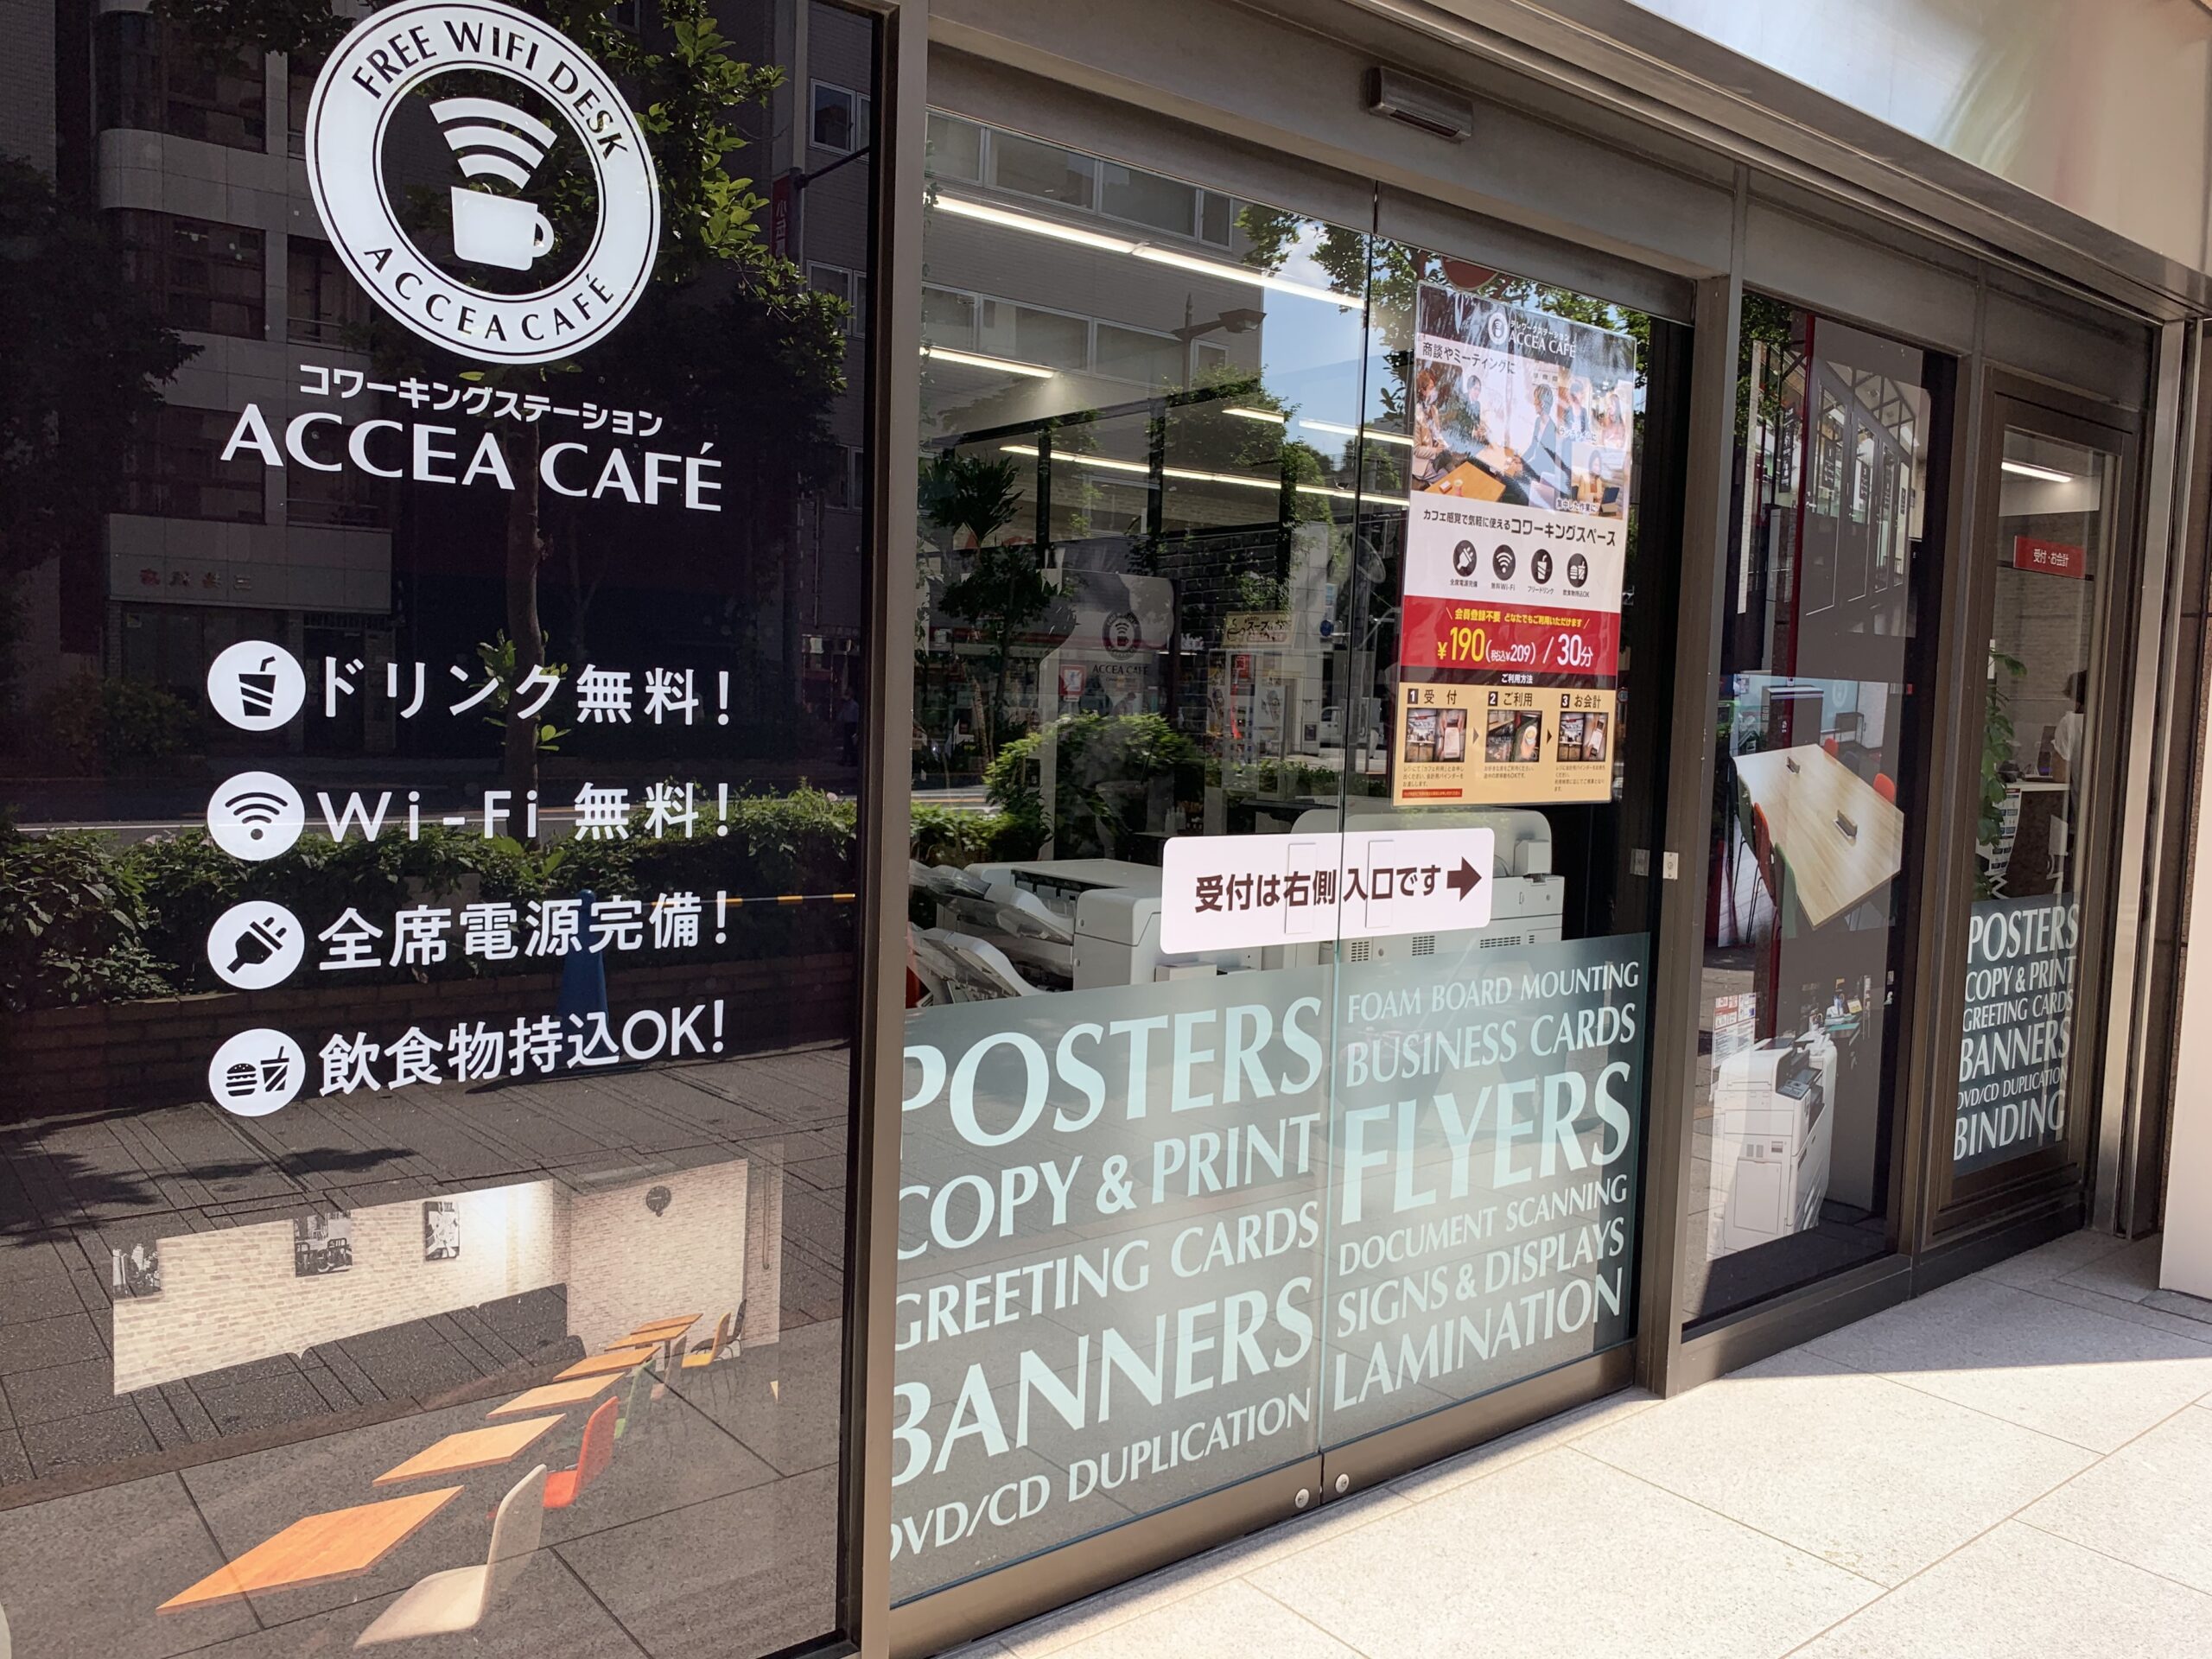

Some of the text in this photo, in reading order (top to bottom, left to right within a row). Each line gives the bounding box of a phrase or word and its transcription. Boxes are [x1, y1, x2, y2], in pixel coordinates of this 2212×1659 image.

[352, 20, 628, 162] FREE WIFI DESK
[364, 246, 614, 343] ACCEA CAFÉ
[1422, 342, 1516, 374] 商談やミーティングに
[1508, 330, 1546, 351] ACCEA
[1510, 320, 1570, 342] テレワークステーション
[299, 364, 663, 437] コワーキングステーション
[220, 403, 722, 512] ACCEA CAFÉ
[1423, 509, 1616, 547] カフェ感覚で気軽に使えるコワーキングスペース
[1556, 499, 1597, 512] 集中した作業に
[1454, 608, 1583, 627] 会員登録不要 どなたでもご利用いただけます
[1528, 586, 1554, 595] フリードリンク
[1092, 664, 1124, 675] ACCEA
[1501, 673, 1533, 685] ご利用方法
[1557, 633, 1593, 667] 30分
[325, 656, 730, 726] ドリンク無料!
[1503, 692, 1533, 707] ご利用
[1574, 695, 1602, 709] お会計
[317, 782, 730, 842] Wi-Fi 無料!
[1195, 864, 1441, 913] 受付は右側入口です
[318, 891, 727, 971] 全席電源完備!
[1967, 903, 2080, 964] POSTERS
[1348, 961, 1639, 1024] FOAM BOARD MOUNTING
[1962, 988, 2074, 1033] GREETING CARDS
[1965, 956, 2077, 1003] COPY & PRINT
[318, 999, 725, 1097] 飲食物持込OK!
[1346, 1002, 1636, 1088] BUSINESS CARDS
[1959, 1016, 2071, 1083] BANNERS
[900, 996, 1323, 1160] POSTERS
[2002, 1065, 2068, 1098] DUPLICATION
[1341, 1061, 1631, 1226] FLYERS
[1953, 1090, 2066, 1161] BINDING
[1096, 1154, 1137, 1214] &
[1151, 1112, 1321, 1205] PRINT
[1338, 1173, 1628, 1276] DOCUMENT SCANNING
[895, 1200, 1319, 1351] GREETING CARDS
[1337, 1217, 1624, 1338] SIGNS & DISPLAYS
[1333, 1268, 1623, 1412] LAMINATION
[892, 1276, 1313, 1488] BANNERS
[1068, 1388, 1311, 1502] DUPLICATION
